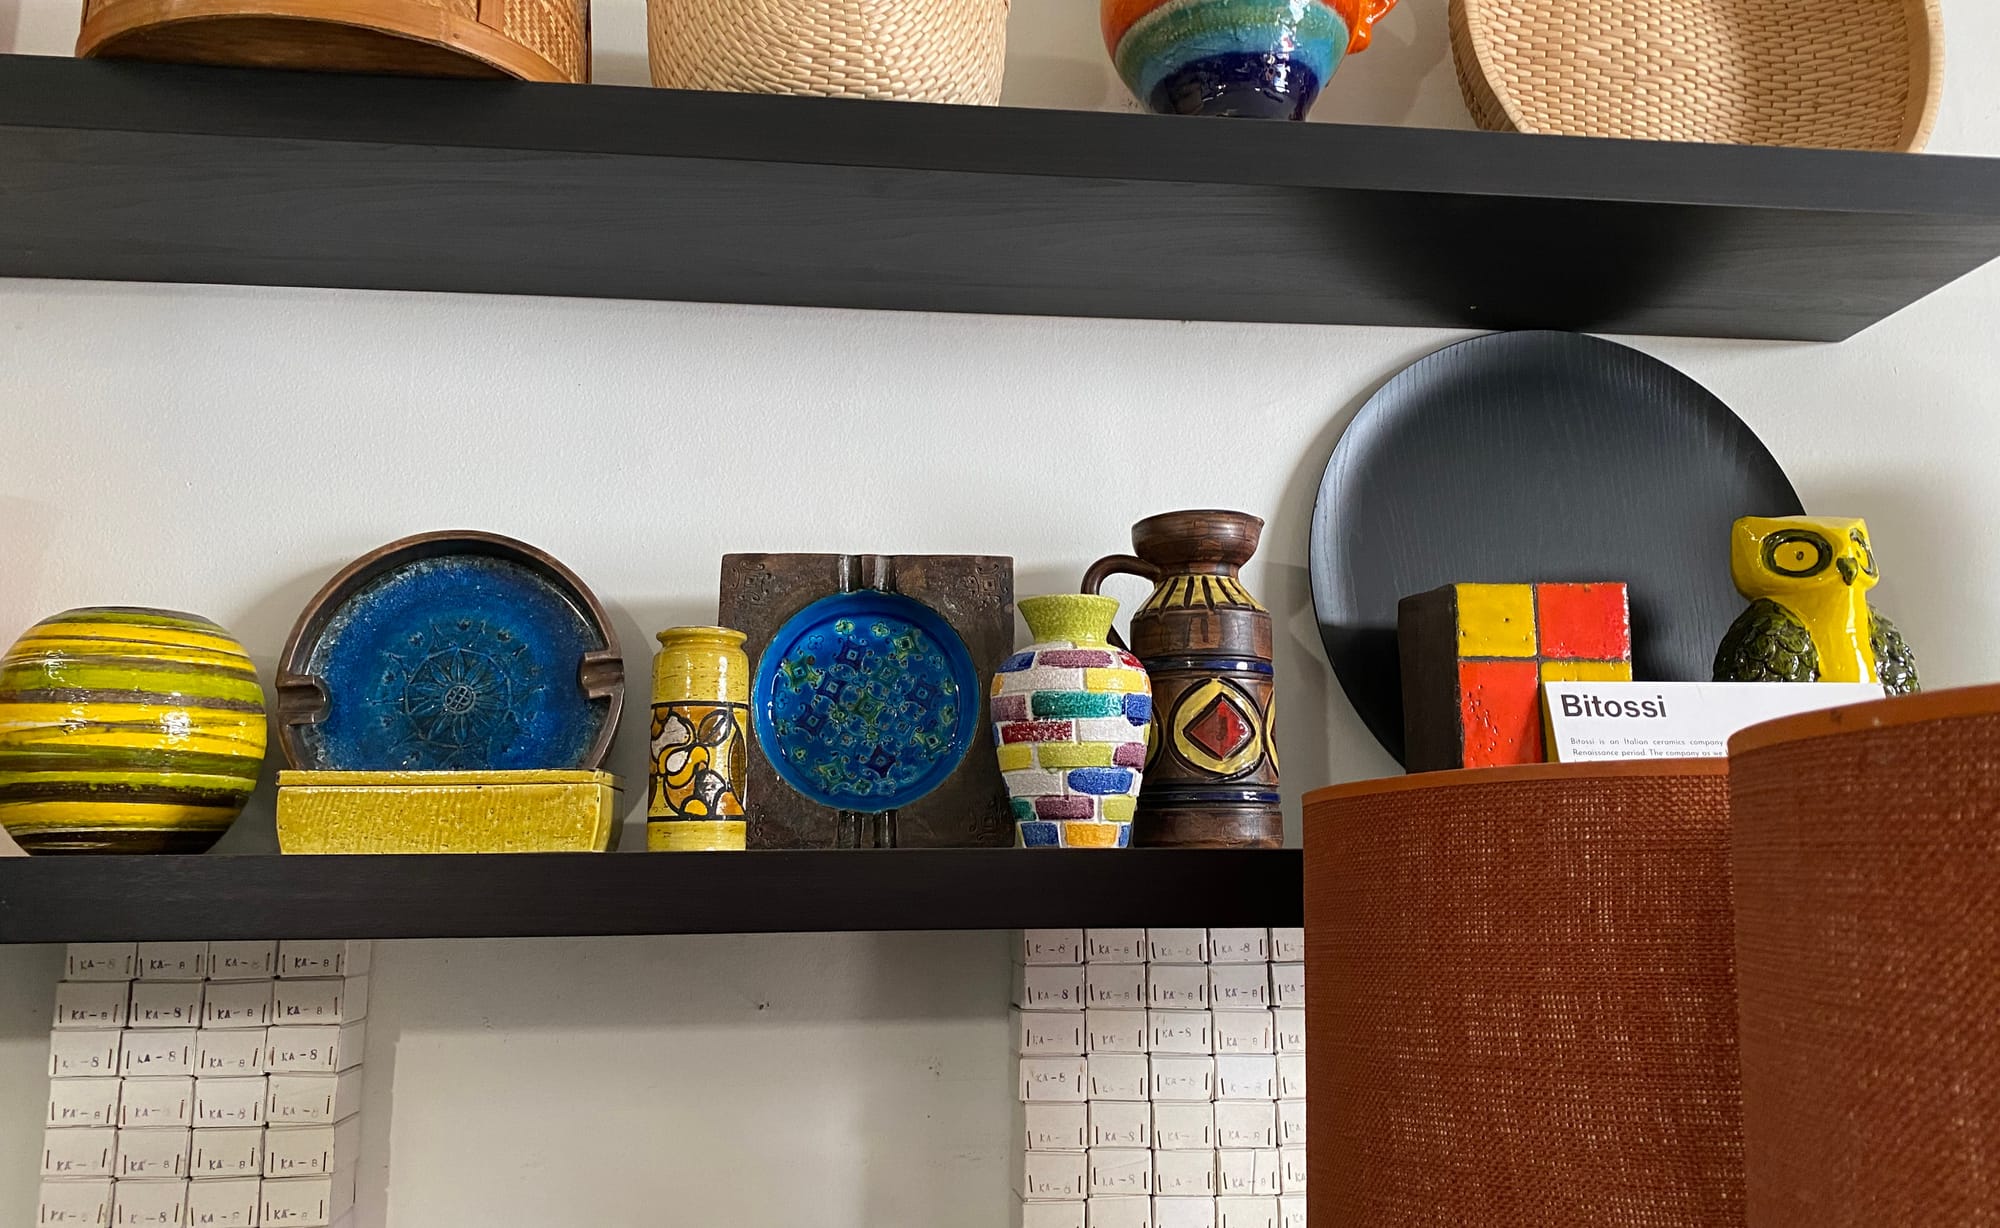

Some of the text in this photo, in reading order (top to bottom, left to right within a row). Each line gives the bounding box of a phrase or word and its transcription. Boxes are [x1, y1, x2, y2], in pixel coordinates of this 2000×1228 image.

[1561, 694, 1668, 718] Bitossi
[1570, 737, 1595, 745] Bitossi
[1599, 737, 1605, 745] is
[1624, 737, 1649, 745] Italian
[1652, 737, 1686, 745] ceramics
[1689, 739, 1723, 748] company
[1572, 748, 1619, 757] Renaissance
[1649, 748, 1664, 757] The
[1665, 750, 1700, 759] company
